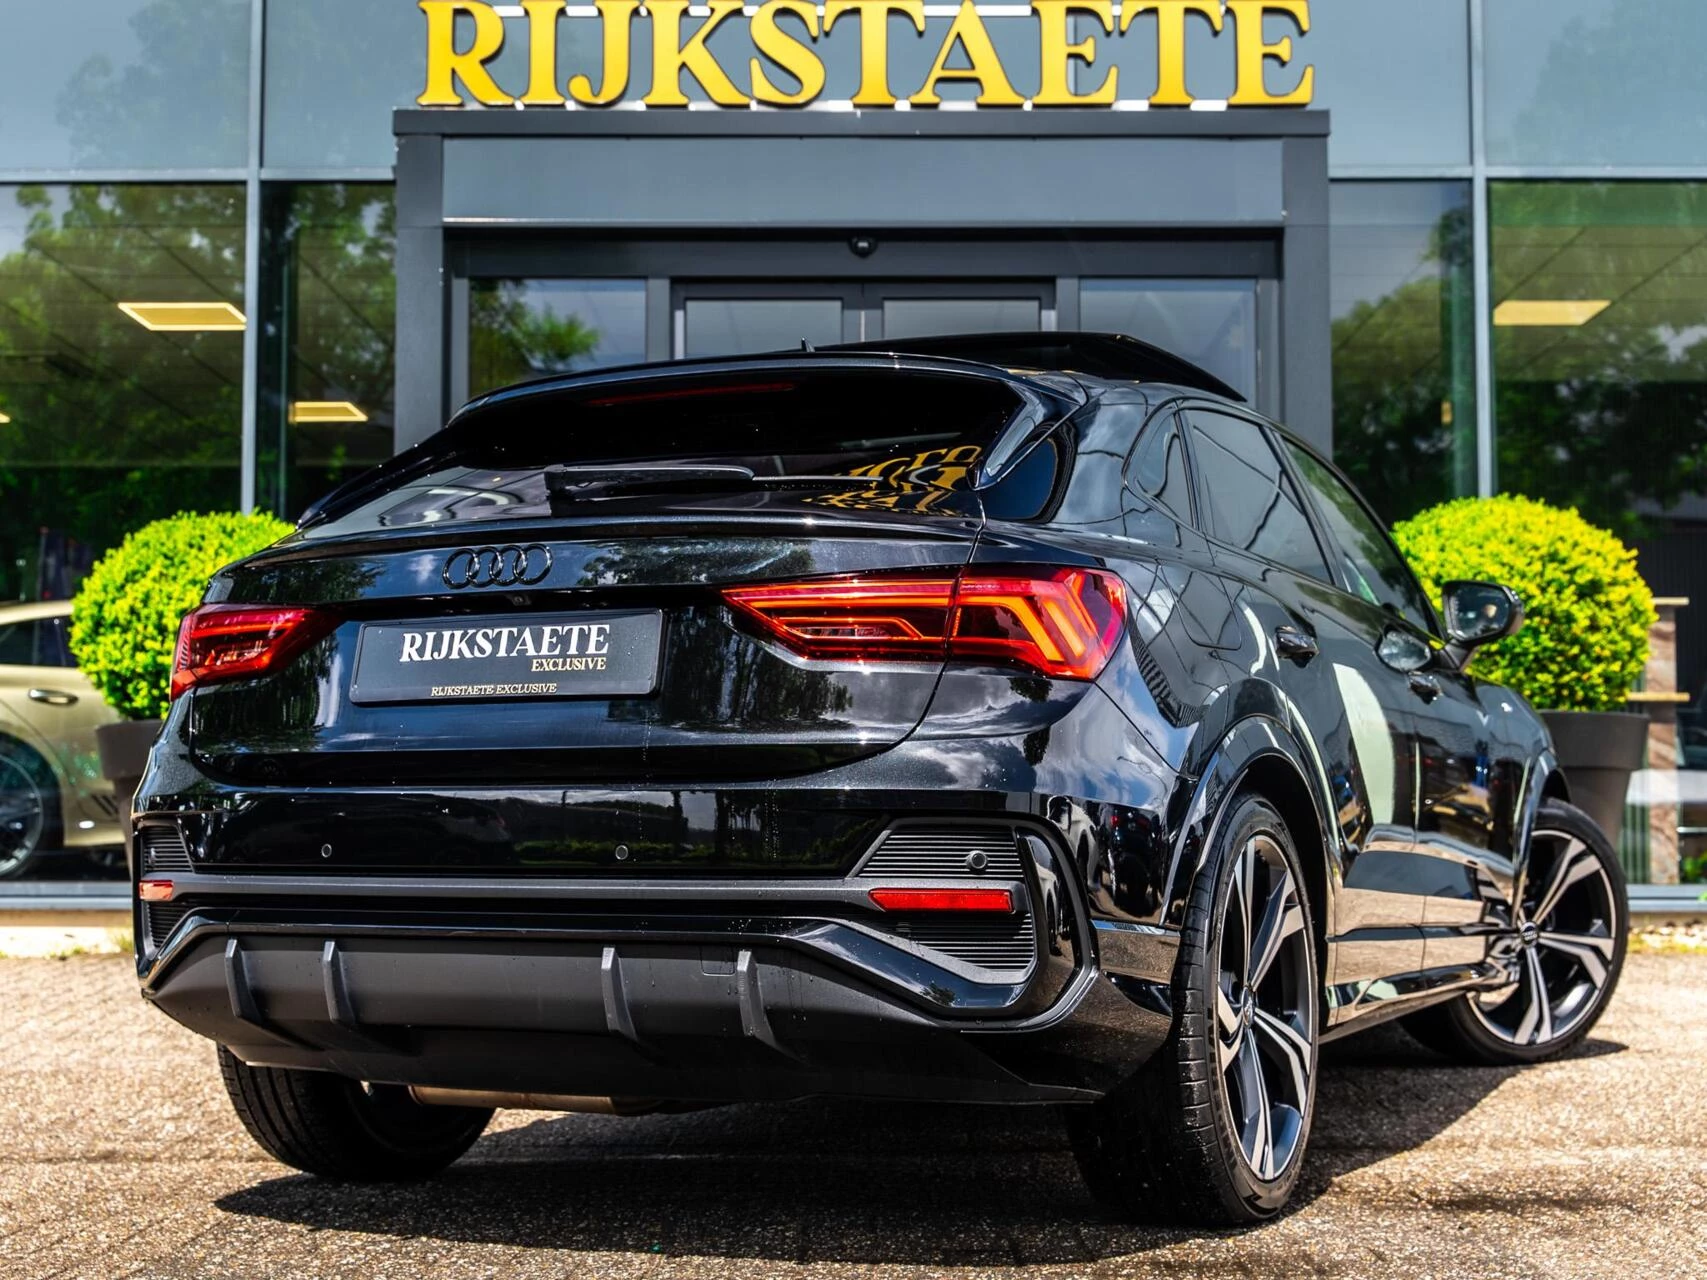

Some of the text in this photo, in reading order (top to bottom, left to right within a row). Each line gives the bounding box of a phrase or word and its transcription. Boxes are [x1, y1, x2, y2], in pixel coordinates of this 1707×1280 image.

[416, 0, 1315, 108] RIJKSTAETE
[400, 624, 610, 662] RIJKSTAETE
[531, 658, 606, 672] EXCLUSIVE
[431, 683, 557, 697] RIJKSTAETE EXCLUSIVE
